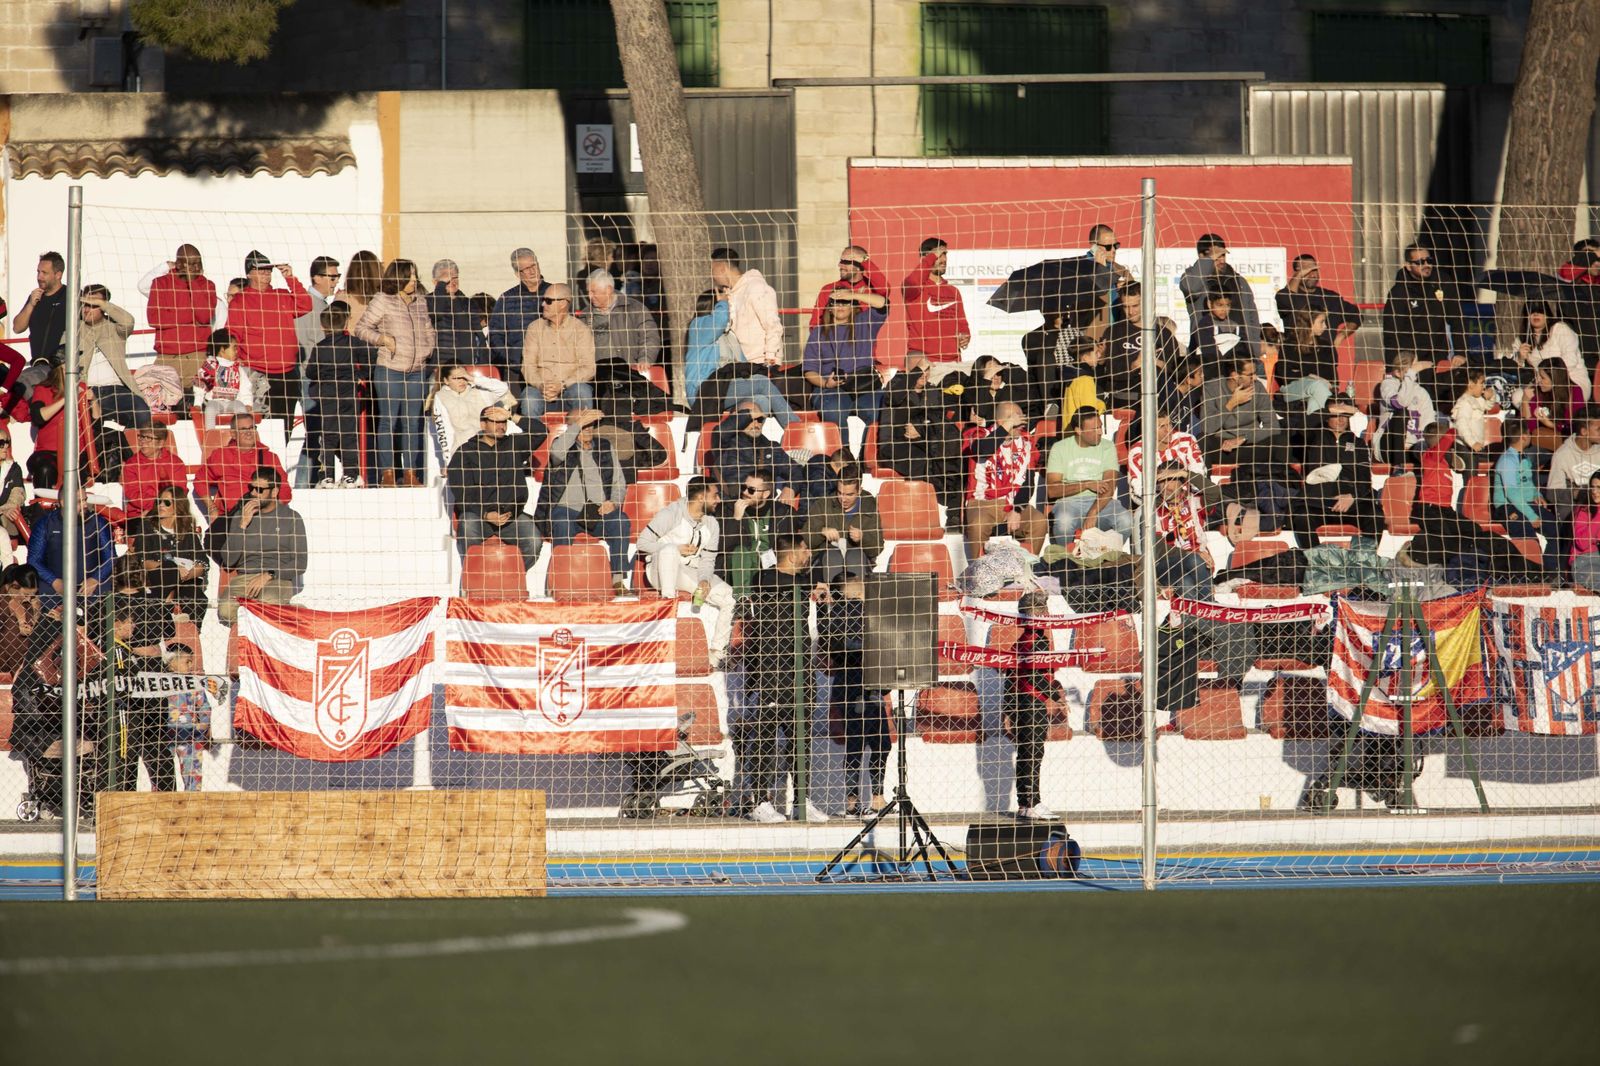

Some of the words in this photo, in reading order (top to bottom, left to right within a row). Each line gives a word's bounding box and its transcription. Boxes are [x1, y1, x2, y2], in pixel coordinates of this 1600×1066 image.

[959, 264, 1015, 276] TORNEO
[1225, 611, 1249, 622] DEL
[990, 654, 1014, 665] DEL
[76, 675, 196, 700] ANUINEGRE
